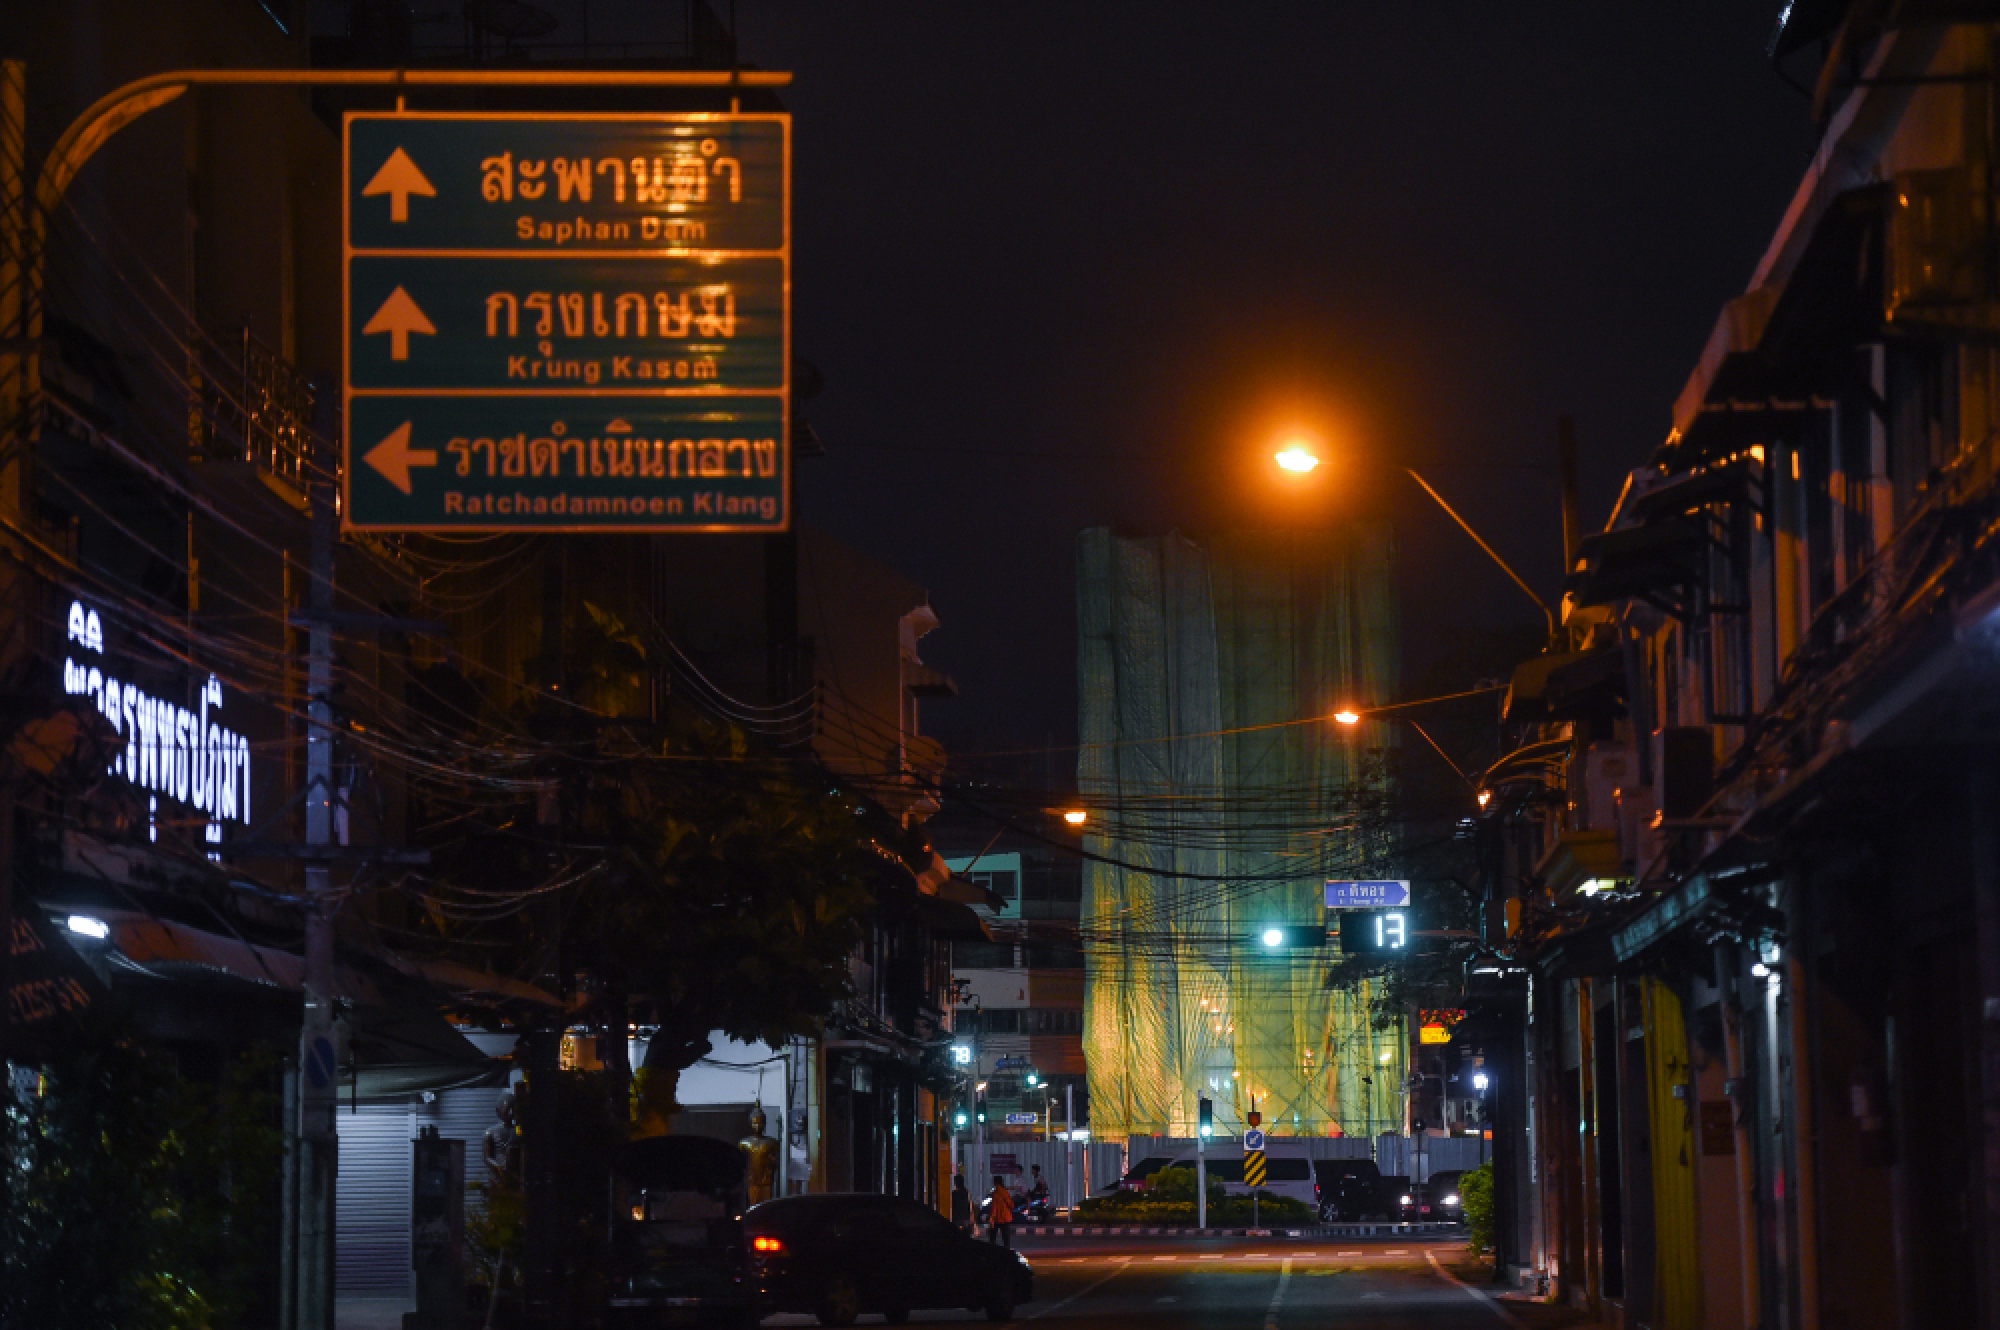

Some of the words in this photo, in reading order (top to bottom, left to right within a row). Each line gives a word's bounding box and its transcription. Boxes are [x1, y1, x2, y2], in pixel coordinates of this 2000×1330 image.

[481, 138, 741, 203] สะพานดำ
[516, 216, 630, 244] Saphan
[641, 216, 706, 240] Dam
[485, 291, 736, 357] กรุงเกษม
[507, 356, 600, 384] Krung
[612, 356, 718, 379] Kasem
[445, 418, 777, 477] ราชดำเนินกลาง
[444, 491, 683, 514] Ratchadamnoen
[693, 491, 777, 519] Klang
[1375, 912, 1405, 949] 13
